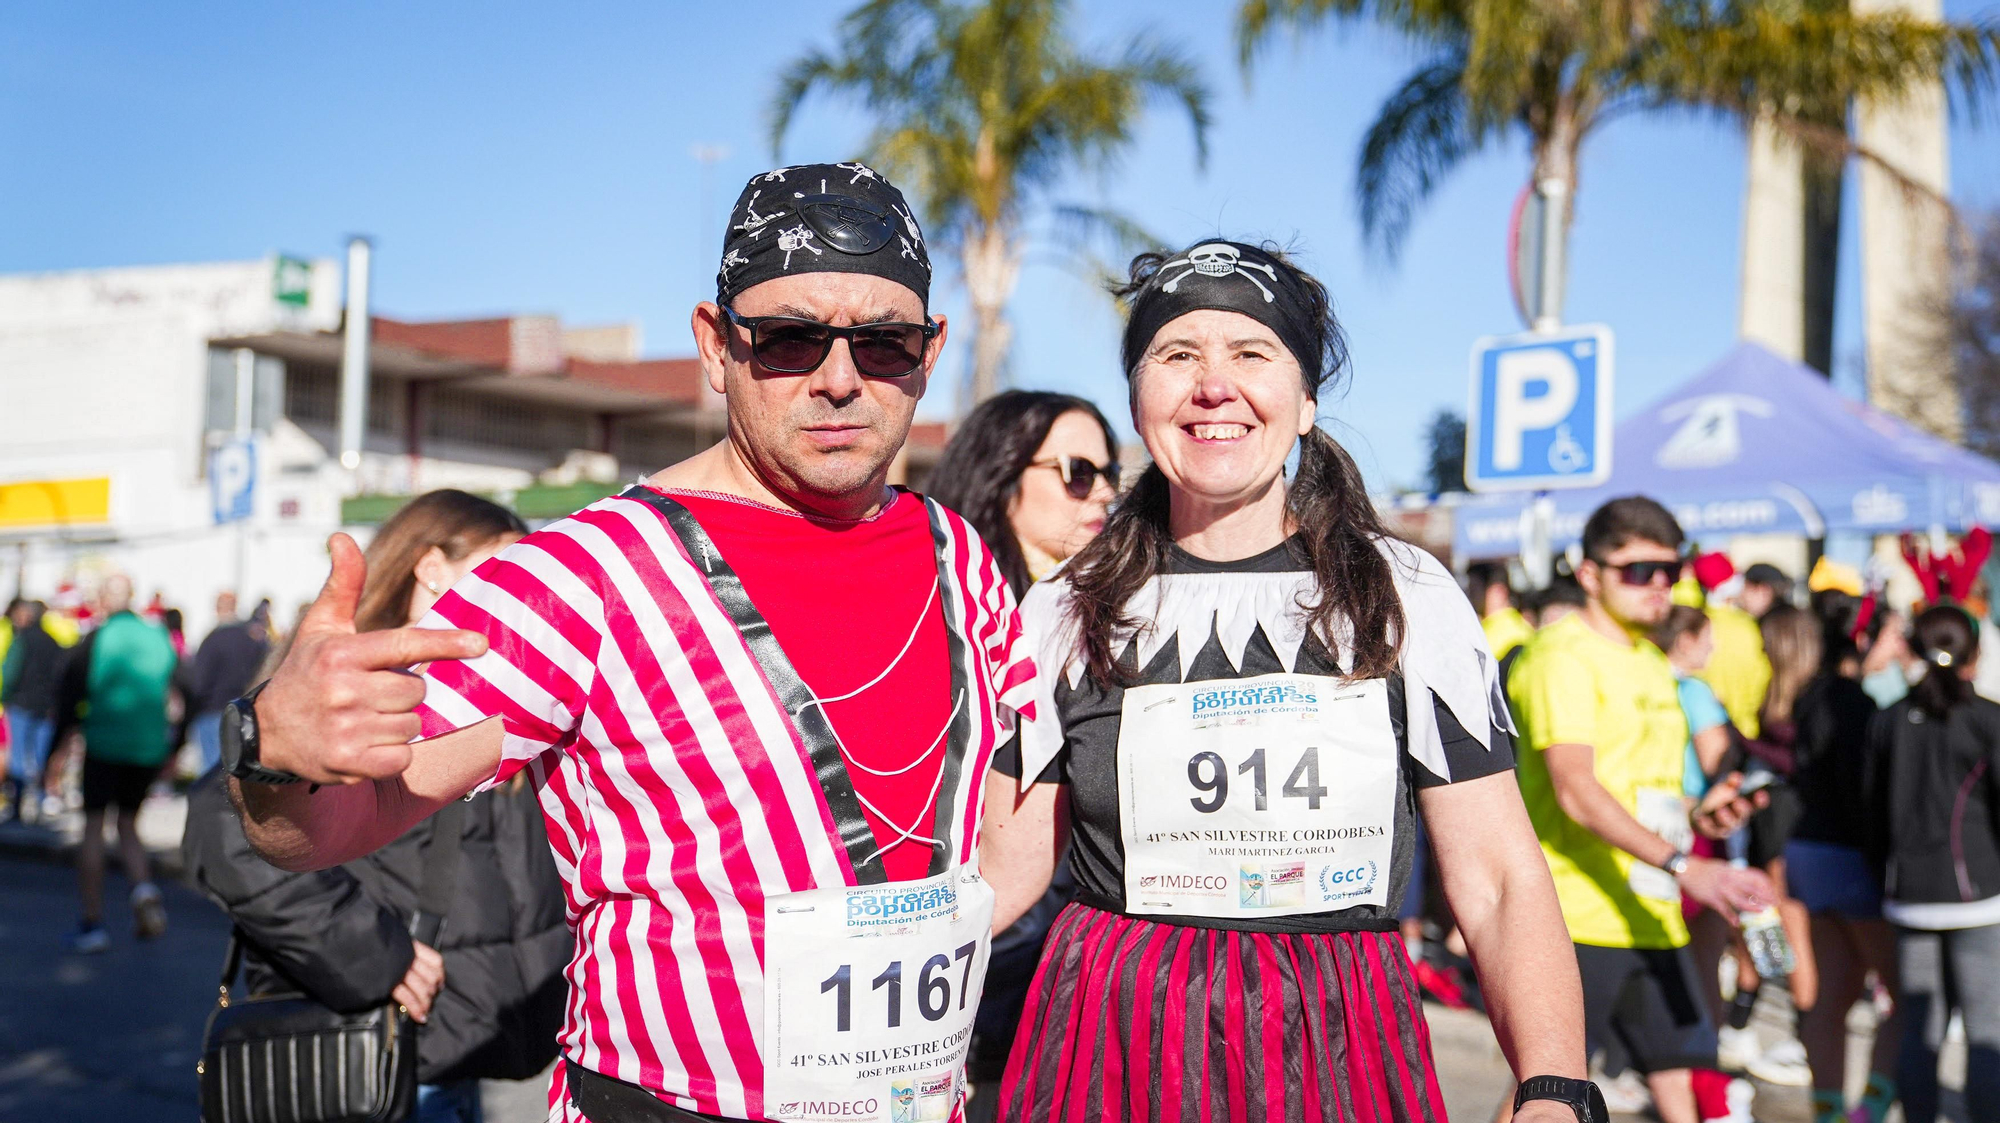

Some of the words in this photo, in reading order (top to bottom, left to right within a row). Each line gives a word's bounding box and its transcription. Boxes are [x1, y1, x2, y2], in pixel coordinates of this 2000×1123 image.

[1493, 347, 1580, 471] P
[218, 446, 249, 512] P
[1192, 685, 1236, 693] CIRCUITO
[1238, 680, 1295, 689] PROVINCIAL
[1192, 685, 1297, 702] carreras
[1193, 693, 1318, 713] populares
[1192, 710, 1251, 720] Diputación
[1187, 747, 1328, 814] 914
[1170, 830, 1200, 842] SAN
[1204, 830, 1288, 842] SILVESTRE
[1292, 826, 1385, 842] CORDOBESA
[1208, 847, 1235, 856] MARI
[1237, 846, 1293, 857] MARTINEZ
[1295, 846, 1336, 855] GARCIA
[1161, 875, 1227, 890] IMDECO
[1279, 871, 1303, 879] PARQUE
[1332, 868, 1364, 884] GCC
[846, 888, 897, 896] CIRCUITO
[900, 880, 947, 894] PROVINCIAL
[846, 885, 949, 906] carreras
[847, 890, 957, 919] populares
[847, 917, 912, 927] Diputación
[931, 904, 959, 919] Córdoba
[821, 940, 977, 1032] 1167
[817, 1053, 850, 1067] SAN
[855, 1040, 940, 1064] SILVESTRE
[856, 1068, 883, 1079] JOSE
[885, 1061, 932, 1075] PERALES
[803, 1098, 878, 1115] IMDECO
